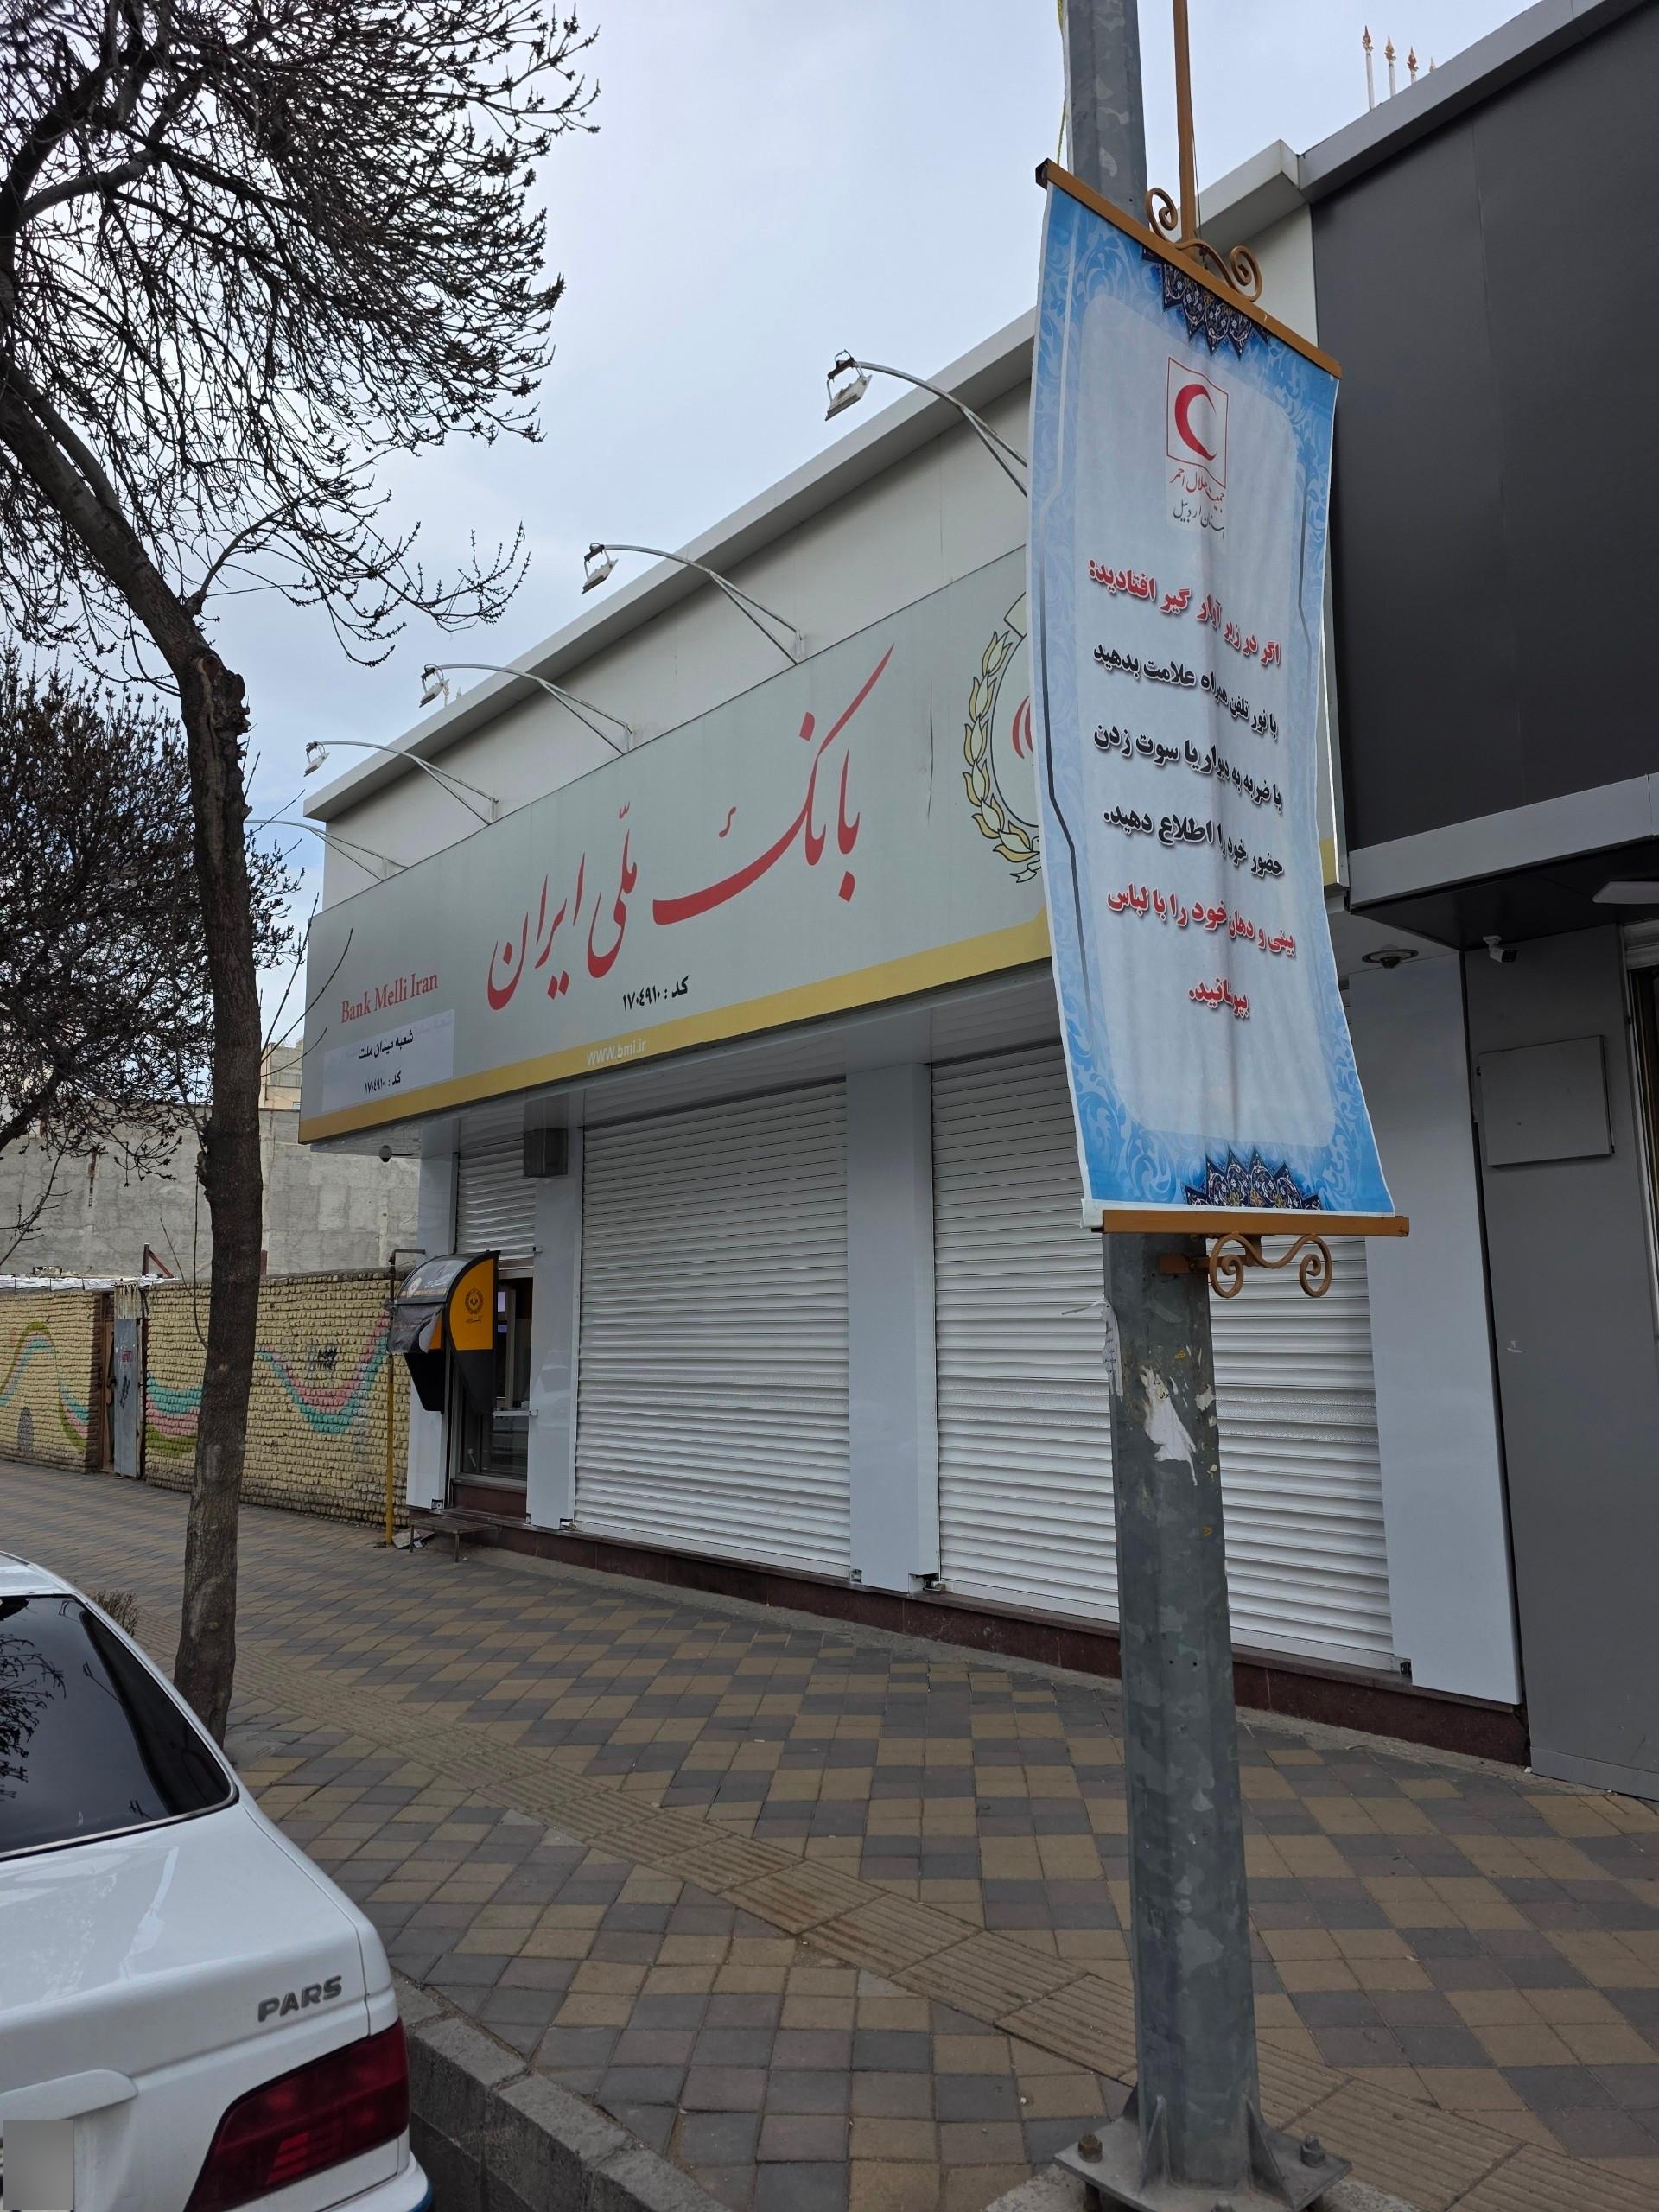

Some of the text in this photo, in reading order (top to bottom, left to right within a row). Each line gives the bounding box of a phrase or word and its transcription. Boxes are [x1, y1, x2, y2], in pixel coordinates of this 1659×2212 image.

[1170, 468, 1185, 486] احمر
[1186, 471, 1207, 493] هلال
[1173, 499, 1202, 523] اردبیل
[1160, 588, 1192, 613] گیر
[1196, 594, 1222, 628] آوار
[1224, 621, 1240, 649] زیر
[1243, 633, 1258, 655] در
[1094, 644, 1140, 677] بدهید
[1260, 640, 1280, 665] اگر
[1143, 660, 1196, 686] علامت
[1230, 695, 1249, 719] تلفن
[1251, 709, 1267, 734] نور
[1268, 713, 1278, 740] با
[1094, 724, 1282, 813] با ضربه به دیوار یا سوت زدن
[652, 642, 895, 925] بانک
[1159, 814, 1213, 843] اطلاع
[1217, 823, 1227, 857] را
[1228, 836, 1247, 865] خود
[1251, 851, 1284, 876] حضور
[487, 851, 586, 1011] ایران
[1107, 883, 1295, 957] بینی و دهان خود را با لباس
[341, 973, 438, 1023] Bank Melli Iran
[358, 1045, 372, 1060] ملت
[374, 1040, 394, 1058] میدان
[395, 1029, 414, 1051] شعبه
[258, 1975, 342, 2023] PARS
